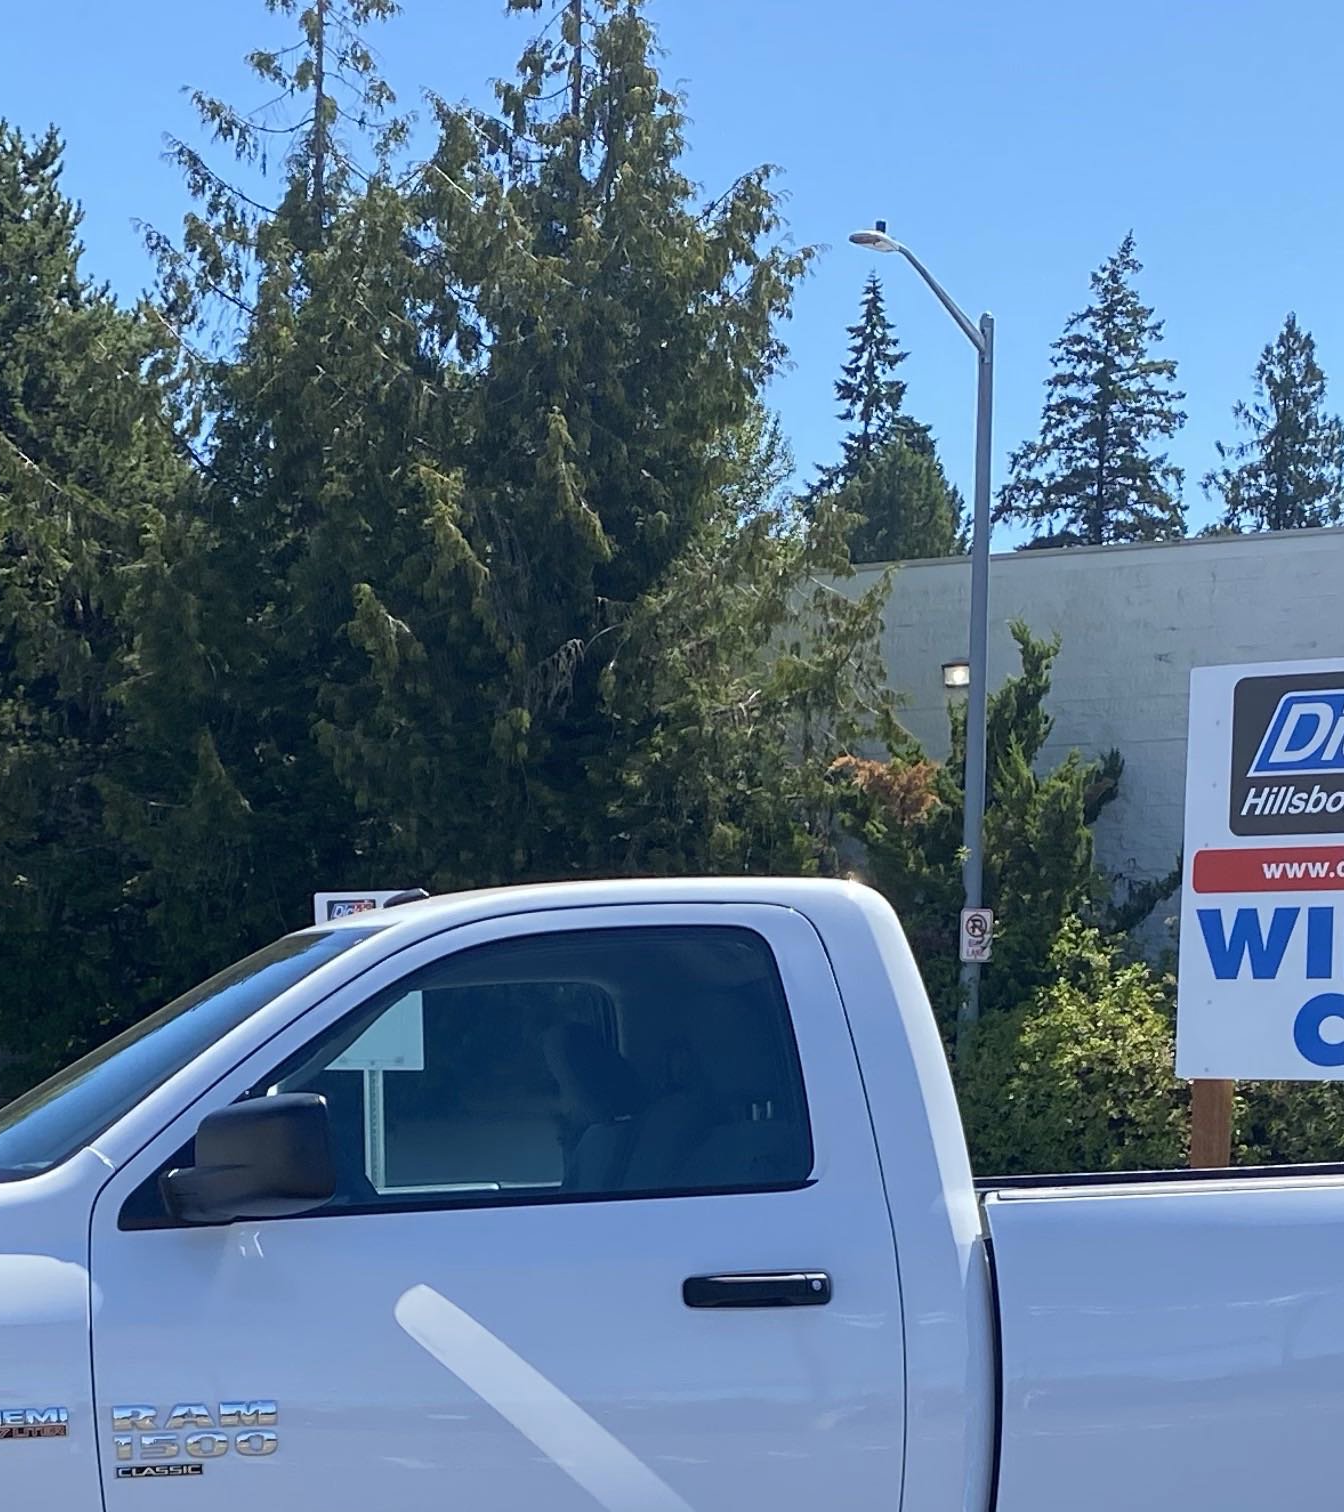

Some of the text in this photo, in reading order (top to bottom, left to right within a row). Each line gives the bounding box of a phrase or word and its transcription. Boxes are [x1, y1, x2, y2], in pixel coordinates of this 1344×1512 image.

[111, 1400, 279, 1432] RAM
[113, 1429, 279, 1461] 1500
[117, 1464, 203, 1478] CLASSIC
